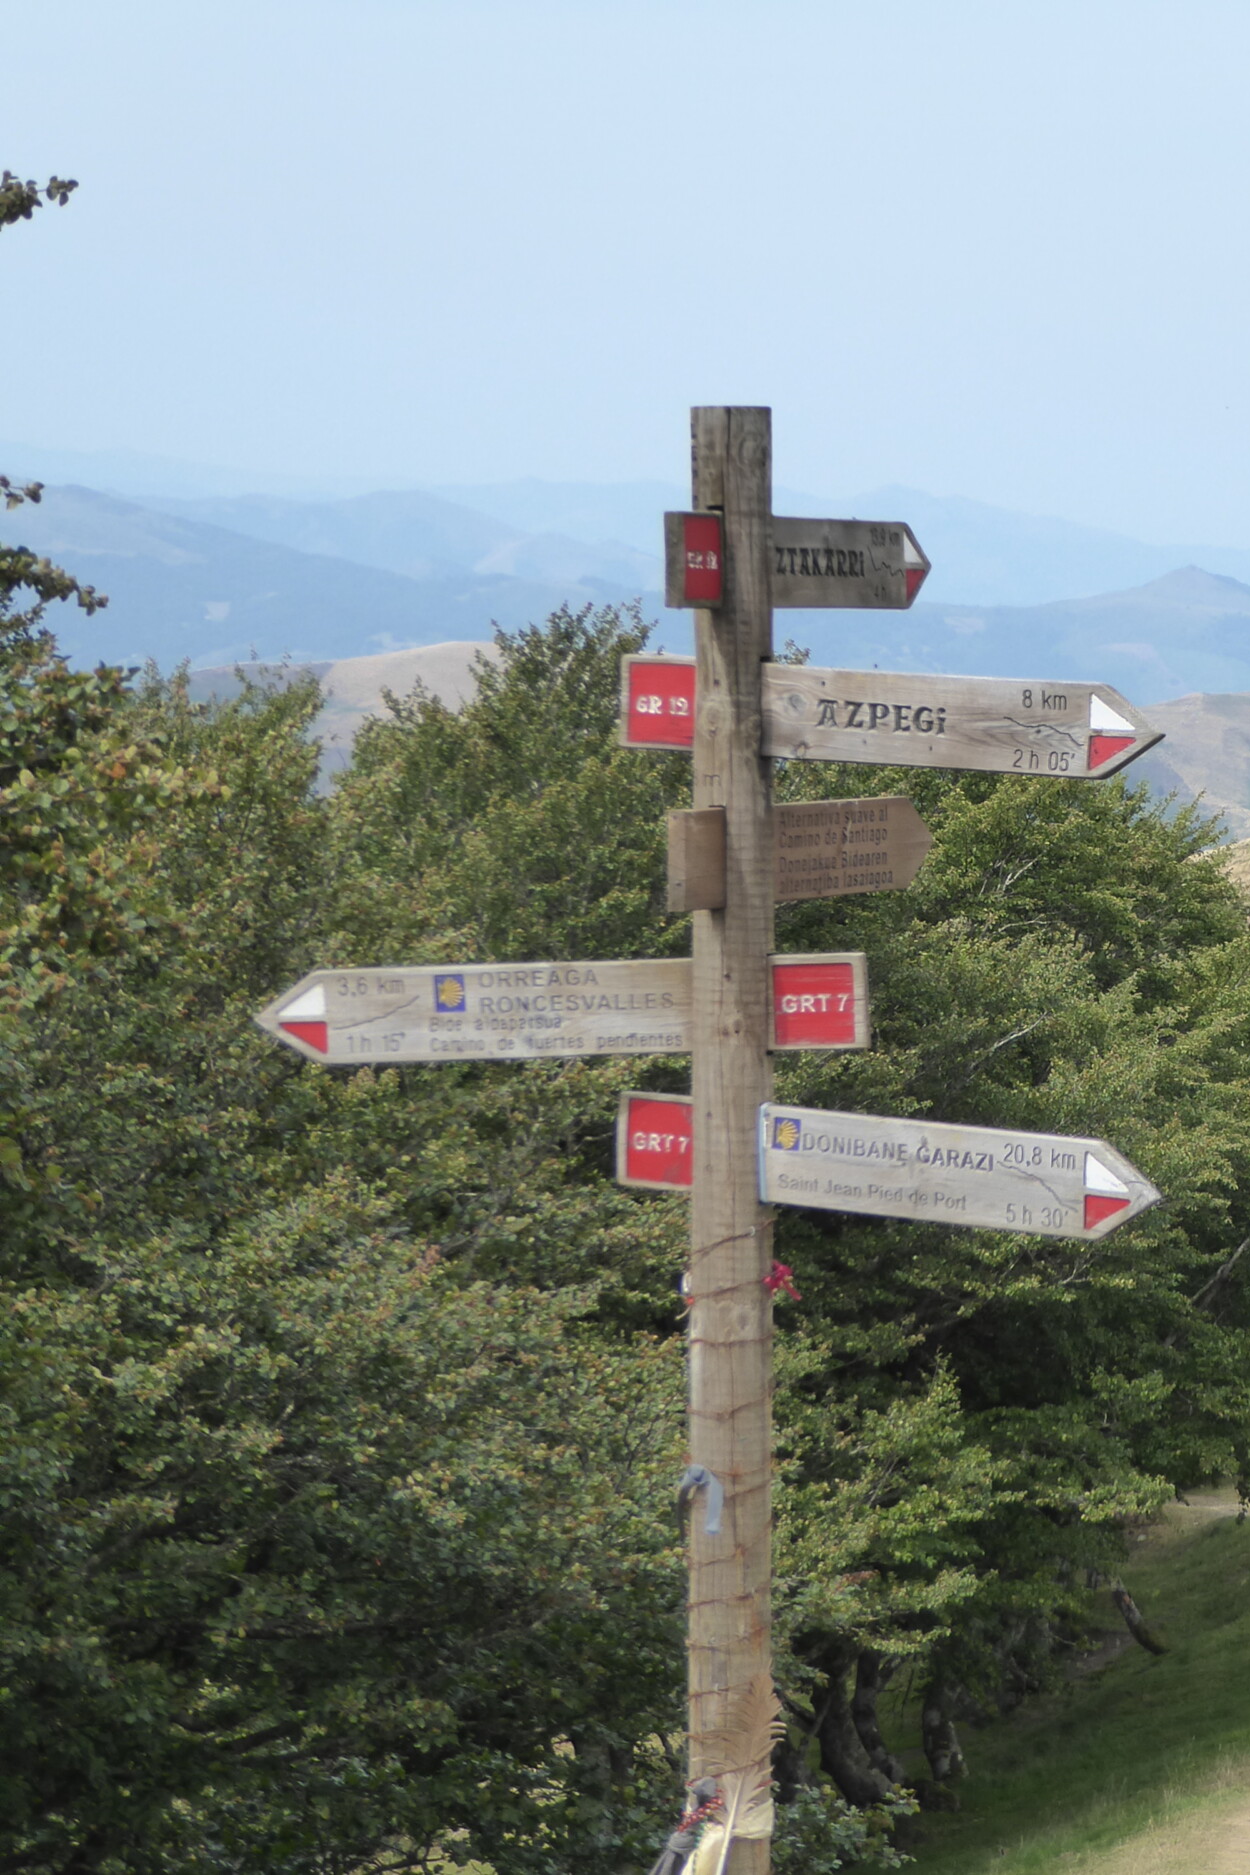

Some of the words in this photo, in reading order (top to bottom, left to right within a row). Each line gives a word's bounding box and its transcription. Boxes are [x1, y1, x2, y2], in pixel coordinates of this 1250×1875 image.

[636, 695, 663, 715] GR
[669, 696, 689, 716] 12
[1022, 689, 1033, 709] 8
[1041, 690, 1067, 711] km
[1012, 748, 1024, 769] 2
[1028, 750, 1040, 769] h
[779, 808, 840, 828] Alternativa
[844, 808, 875, 824] suave
[879, 804, 888, 822] al
[779, 831, 820, 848] Camino
[824, 828, 837, 845] de
[841, 826, 888, 846] Santiago
[779, 855, 837, 875] Donejakue
[841, 850, 888, 869] Bidearen
[843, 870, 893, 889] lasaiagoa
[376, 976, 405, 995] km
[477, 969, 599, 988] ORREAGA
[479, 992, 675, 1014] RONCESVALLES
[782, 994, 831, 1013] GRT
[837, 993, 850, 1012] 7
[430, 1037, 485, 1053] Camino
[497, 1037, 516, 1051] de
[523, 1033, 585, 1050] fuertes
[596, 1032, 684, 1049] pendientes
[633, 1131, 674, 1152] GRT
[678, 1136, 690, 1153] 7
[802, 1133, 909, 1162] DONIBANE
[915, 1142, 995, 1173] GARAZI
[1003, 1143, 1043, 1167] 20,8
[1051, 1148, 1077, 1170] km
[778, 1173, 819, 1193] Saint
[823, 1178, 863, 1198] Jean
[866, 1183, 904, 1201] Pied
[909, 1188, 929, 1207] de
[933, 1191, 968, 1211] Port
[1006, 1202, 1017, 1223] 5
[1022, 1204, 1033, 1225] h
